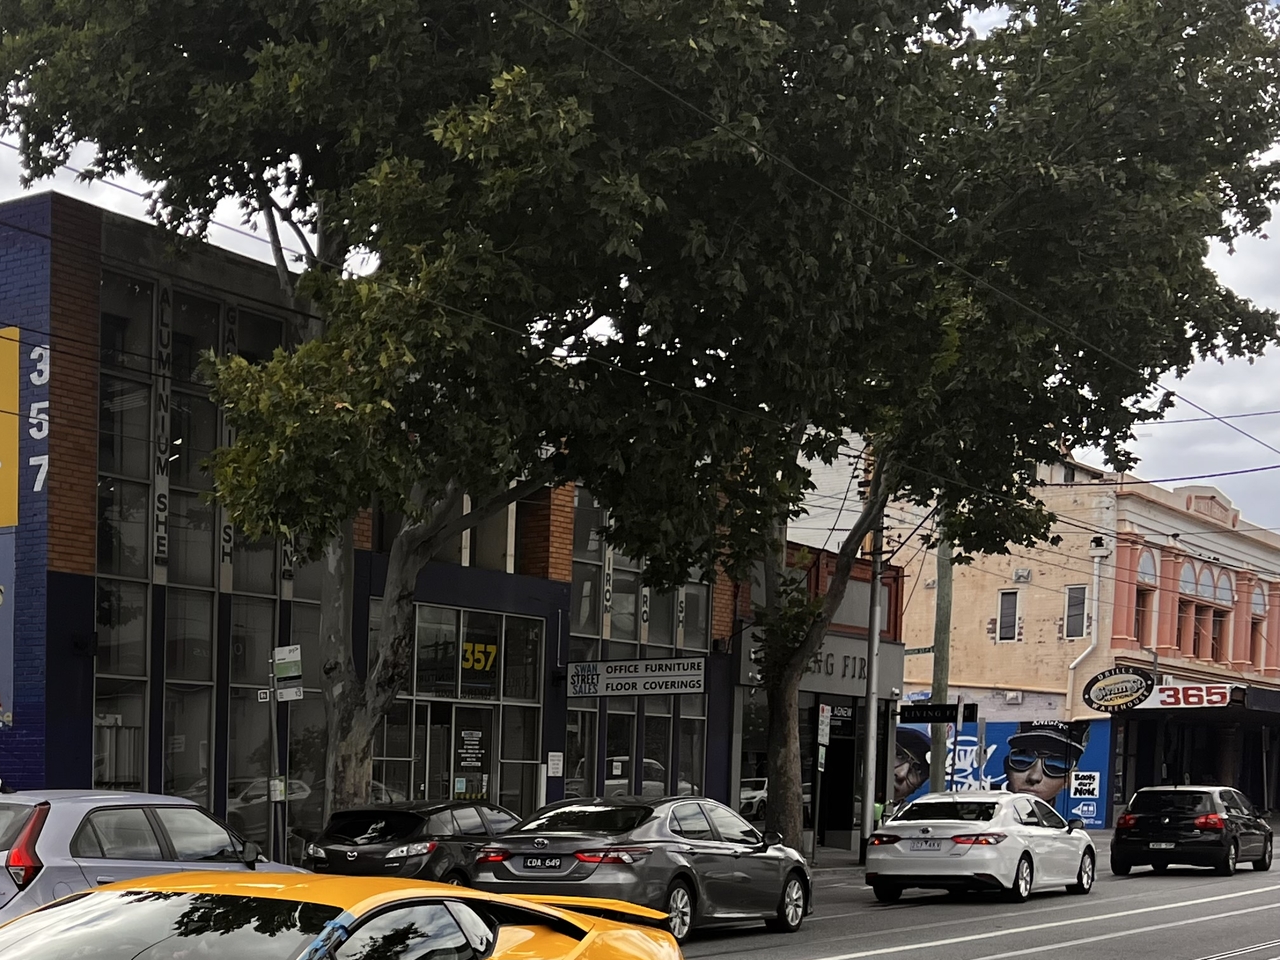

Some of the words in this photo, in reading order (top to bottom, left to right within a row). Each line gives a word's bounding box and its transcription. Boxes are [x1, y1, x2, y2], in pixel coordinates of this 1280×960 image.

[155, 286, 172, 477] ALUMINIUM
[461, 642, 497, 671] 357
[574, 664, 598, 674] SWAN
[606, 664, 639, 674] OFFICE
[645, 662, 702, 673] FURNITURE
[842, 654, 868, 680] FIR
[570, 674, 600, 685] STREET
[1097, 668, 1134, 680] DRILLS
[573, 684, 598, 695] SALES
[606, 682, 637, 691] FLOOR
[643, 680, 702, 690] COVERINGS
[1096, 686, 1128, 700] Swan
[1103, 694, 1134, 703] AUCTIONS
[1160, 686, 1227, 706] 365
[1091, 691, 1149, 712] WAREHOUSE
[904, 710, 941, 718] LIVING
[946, 709, 970, 717] FIE
